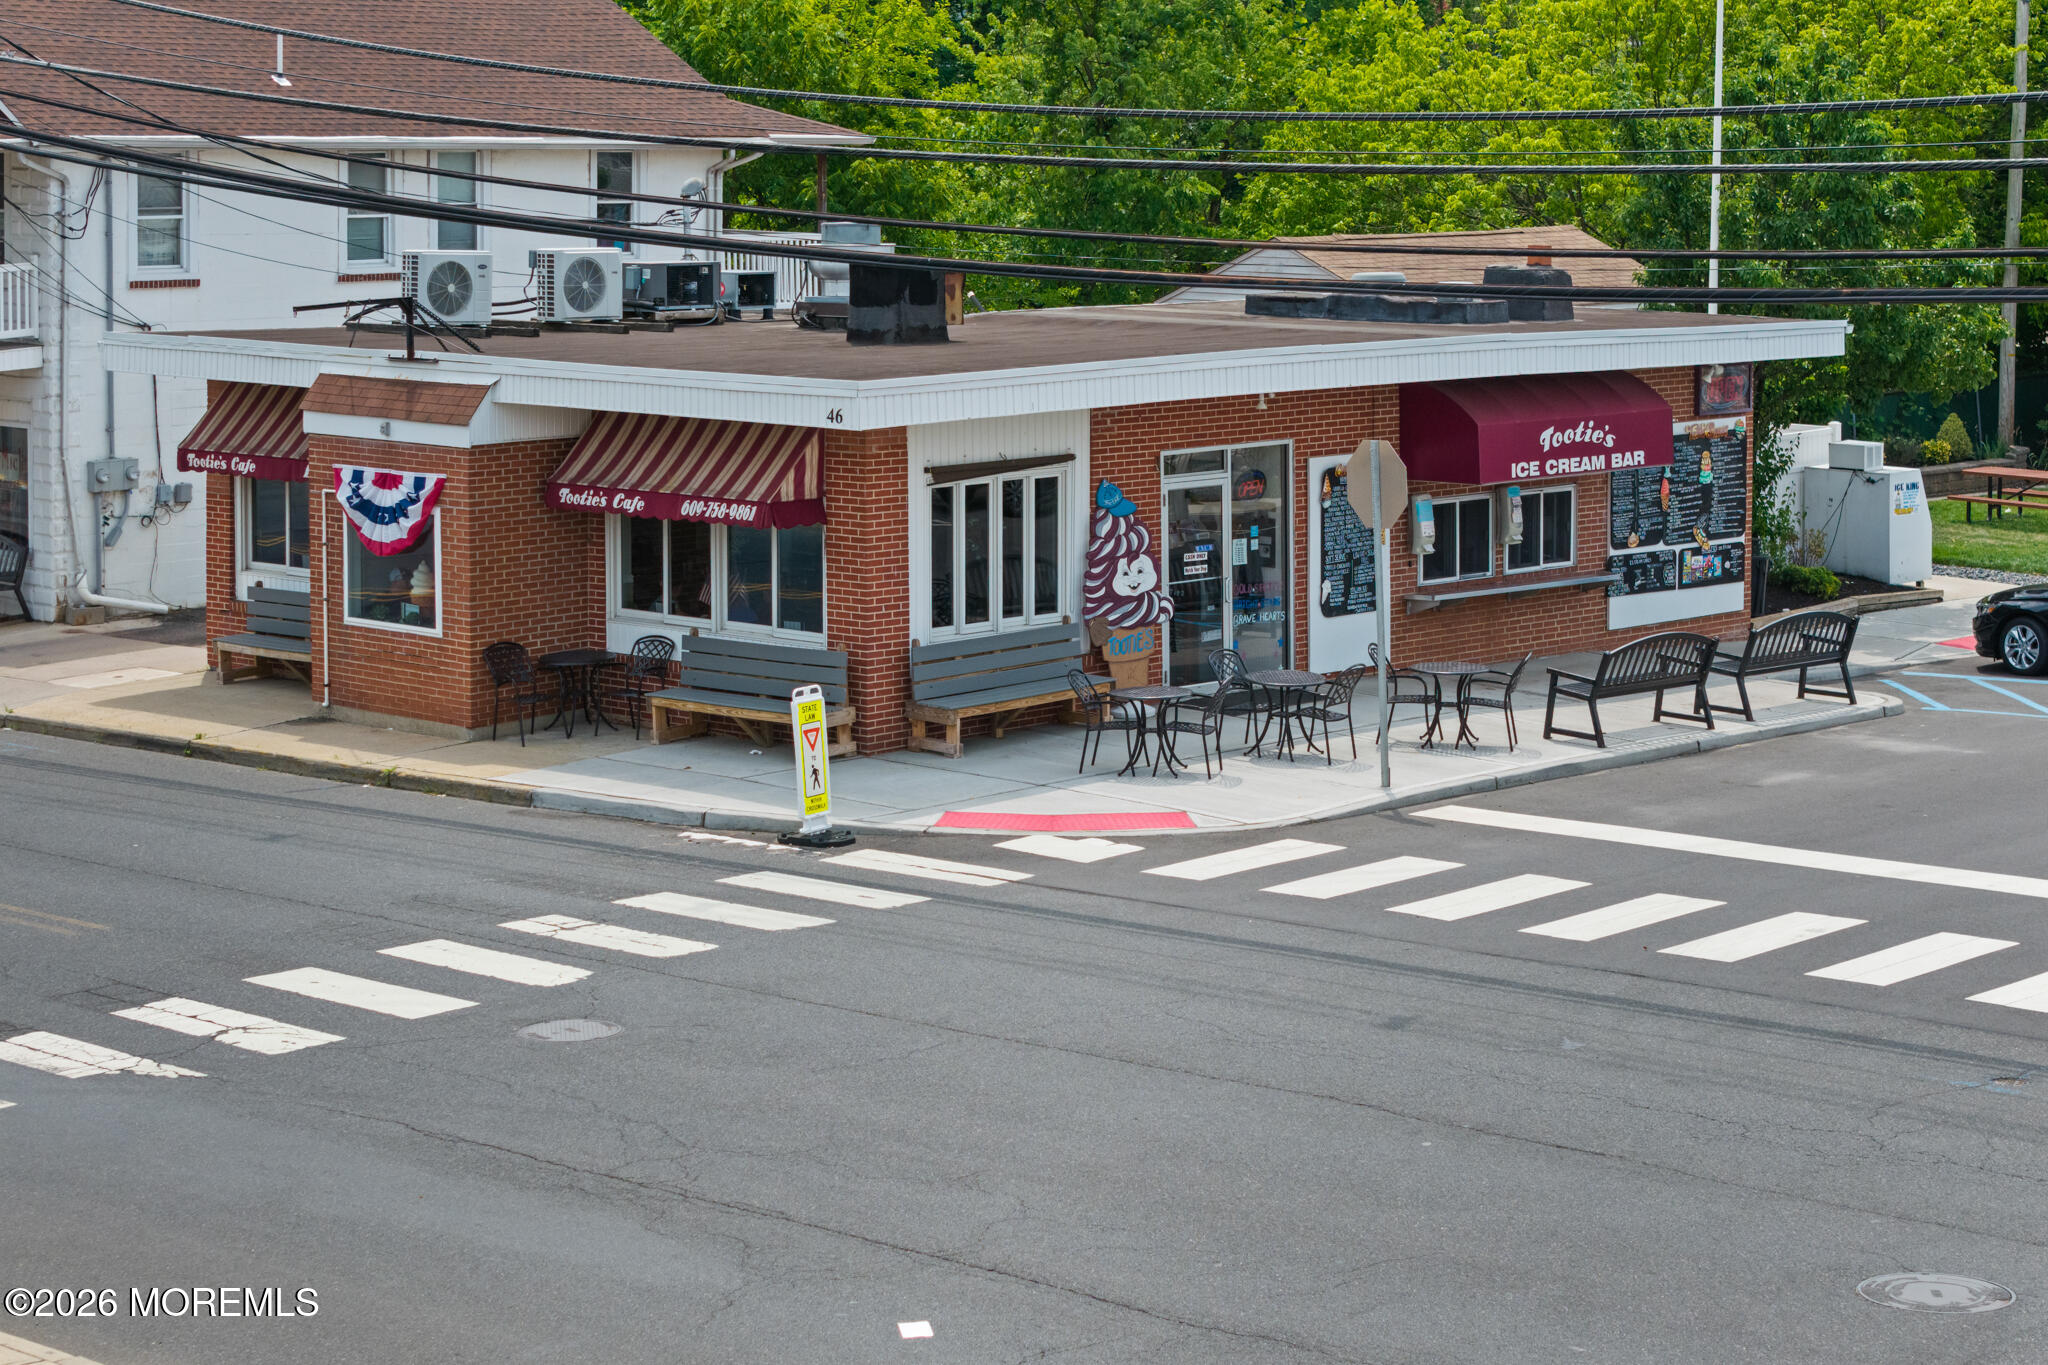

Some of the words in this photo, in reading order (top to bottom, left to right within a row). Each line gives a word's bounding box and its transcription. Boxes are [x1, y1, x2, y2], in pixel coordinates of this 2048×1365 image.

[826, 407, 843, 424] 46
[1539, 420, 1617, 453] Tootie's
[186, 453, 227, 470] Tootie's
[231, 456, 256, 474] Cafe
[1511, 461, 1540, 478] ICE
[1545, 454, 1605, 475] CREAM
[1611, 450, 1645, 468] BAR
[1238, 479, 1265, 498] OPEN
[1895, 482, 1904, 491] ICE
[558, 487, 607, 508] Tootie's
[612, 492, 645, 513] Cafe
[680, 499, 757, 522] 609-758-9861
[1233, 613, 1257, 627] BRAVE
[1260, 610, 1286, 622] HEARTS
[1108, 628, 1154, 656] TOOTIE'S
[801, 704, 817, 714] STATE
[805, 713, 816, 721] LAW
